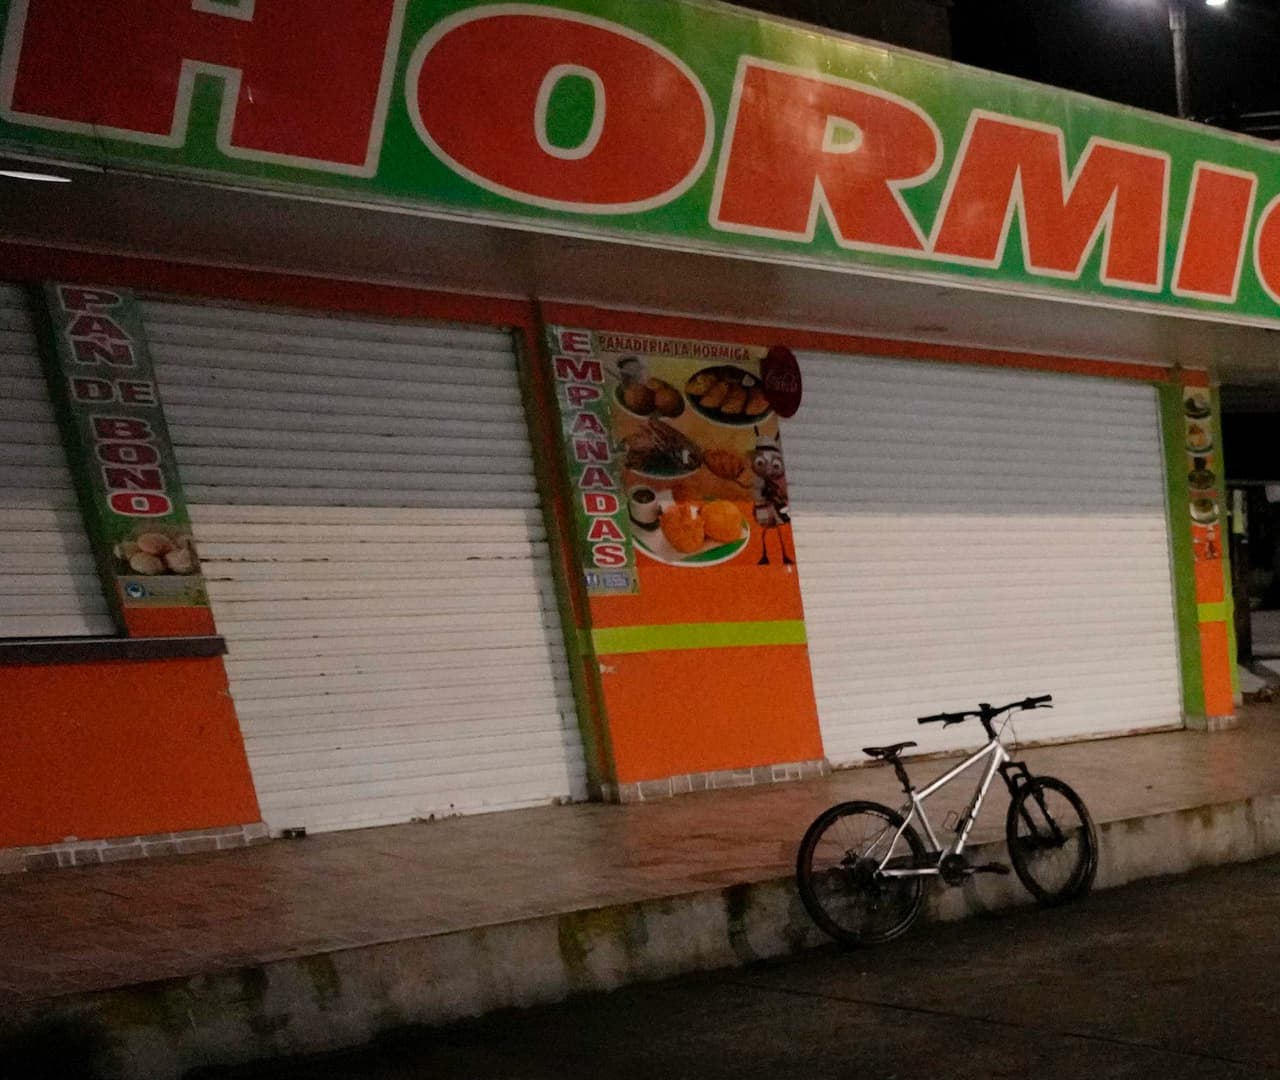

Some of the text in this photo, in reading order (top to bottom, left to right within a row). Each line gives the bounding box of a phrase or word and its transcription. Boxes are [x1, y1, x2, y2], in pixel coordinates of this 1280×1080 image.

[58, 285, 173, 517] PAN DE BONO
[553, 330, 627, 567] EMPANADAS
[693, 343, 751, 361] HORMIGA
